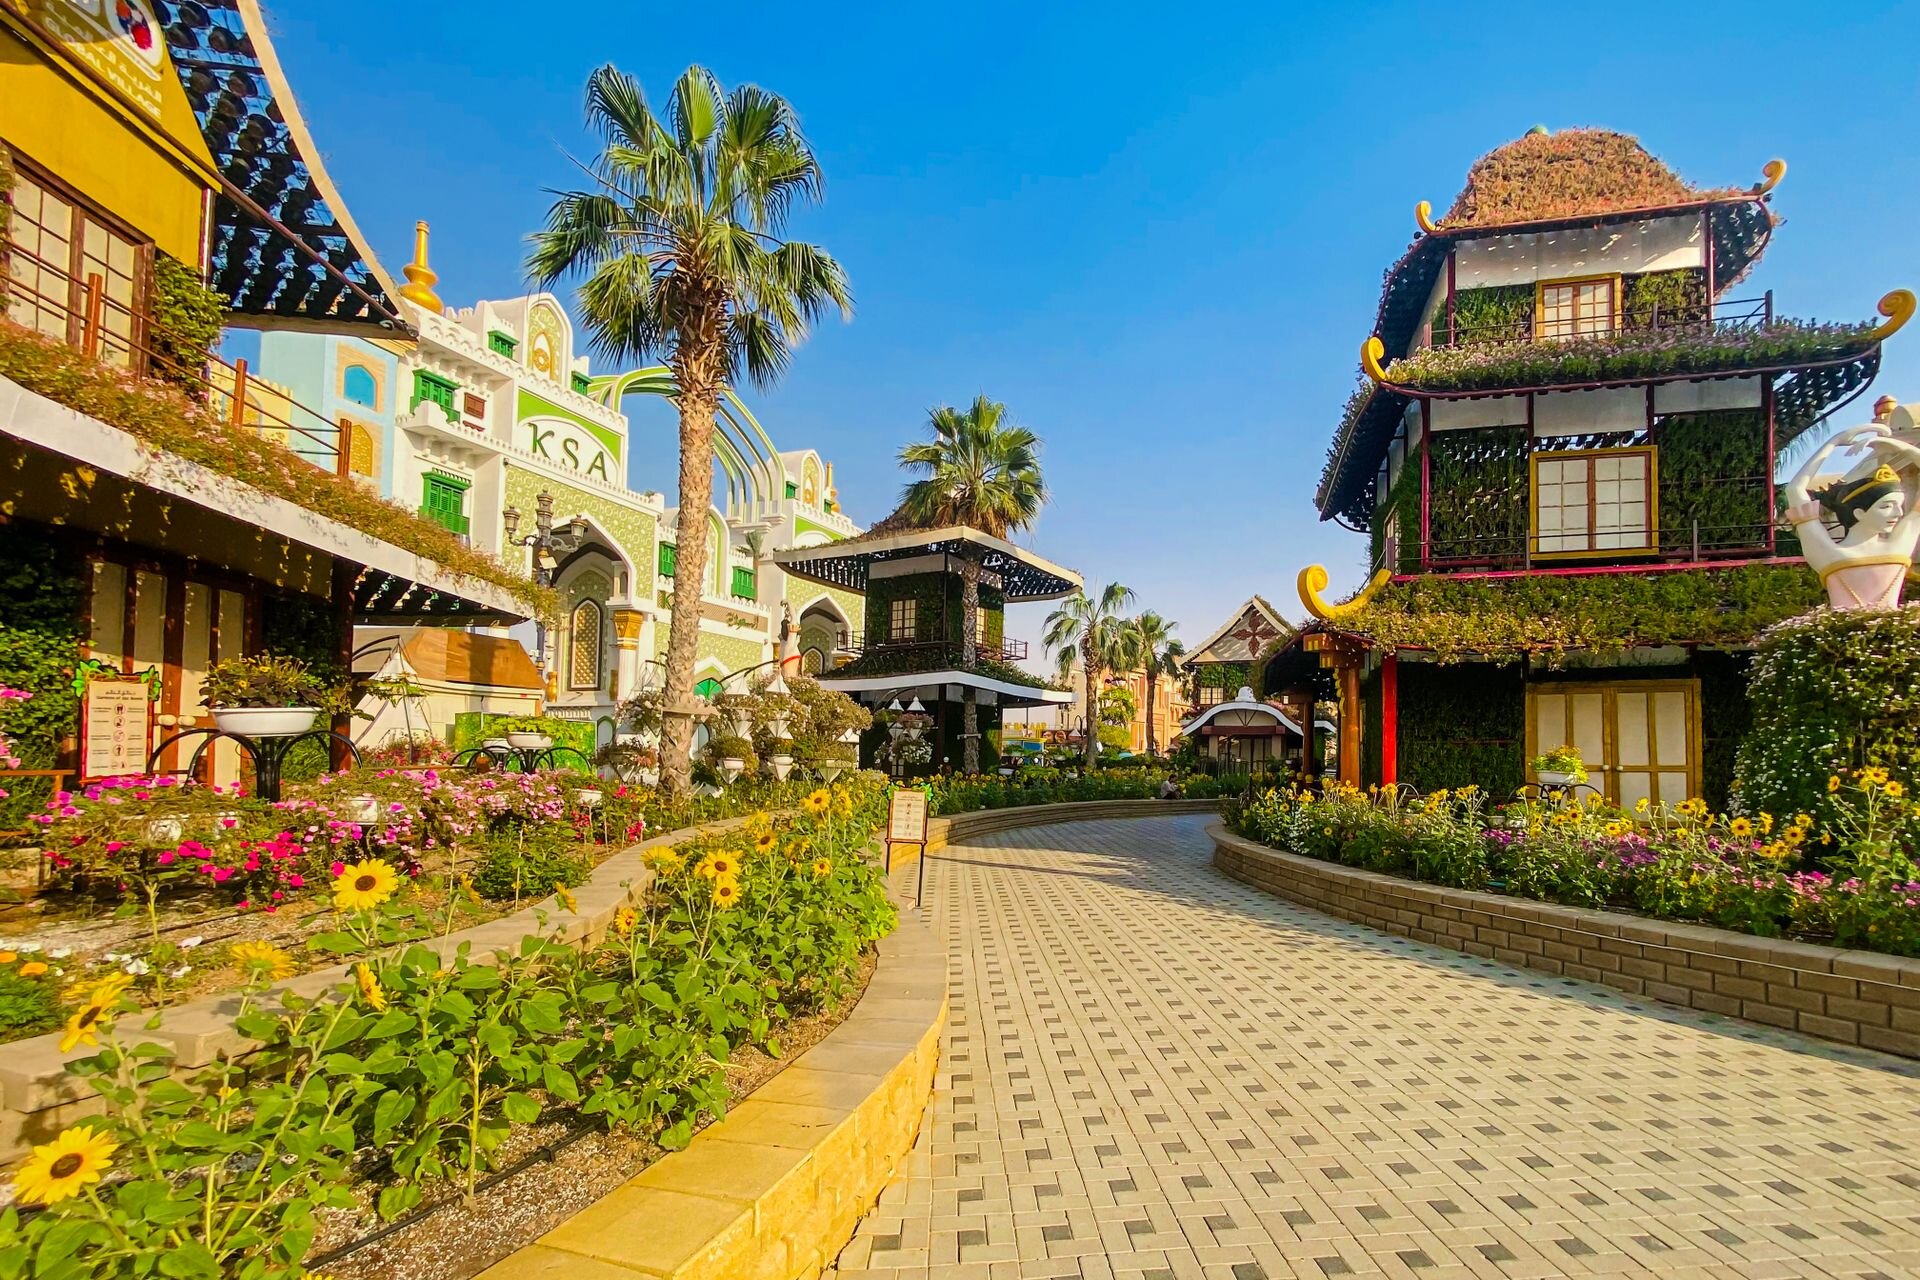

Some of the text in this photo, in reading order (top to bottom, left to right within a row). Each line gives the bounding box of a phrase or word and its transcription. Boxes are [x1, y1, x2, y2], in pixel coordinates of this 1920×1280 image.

[43, 16, 161, 120] GLOBAL VILLAGE
[527, 422, 608, 482] KSA
